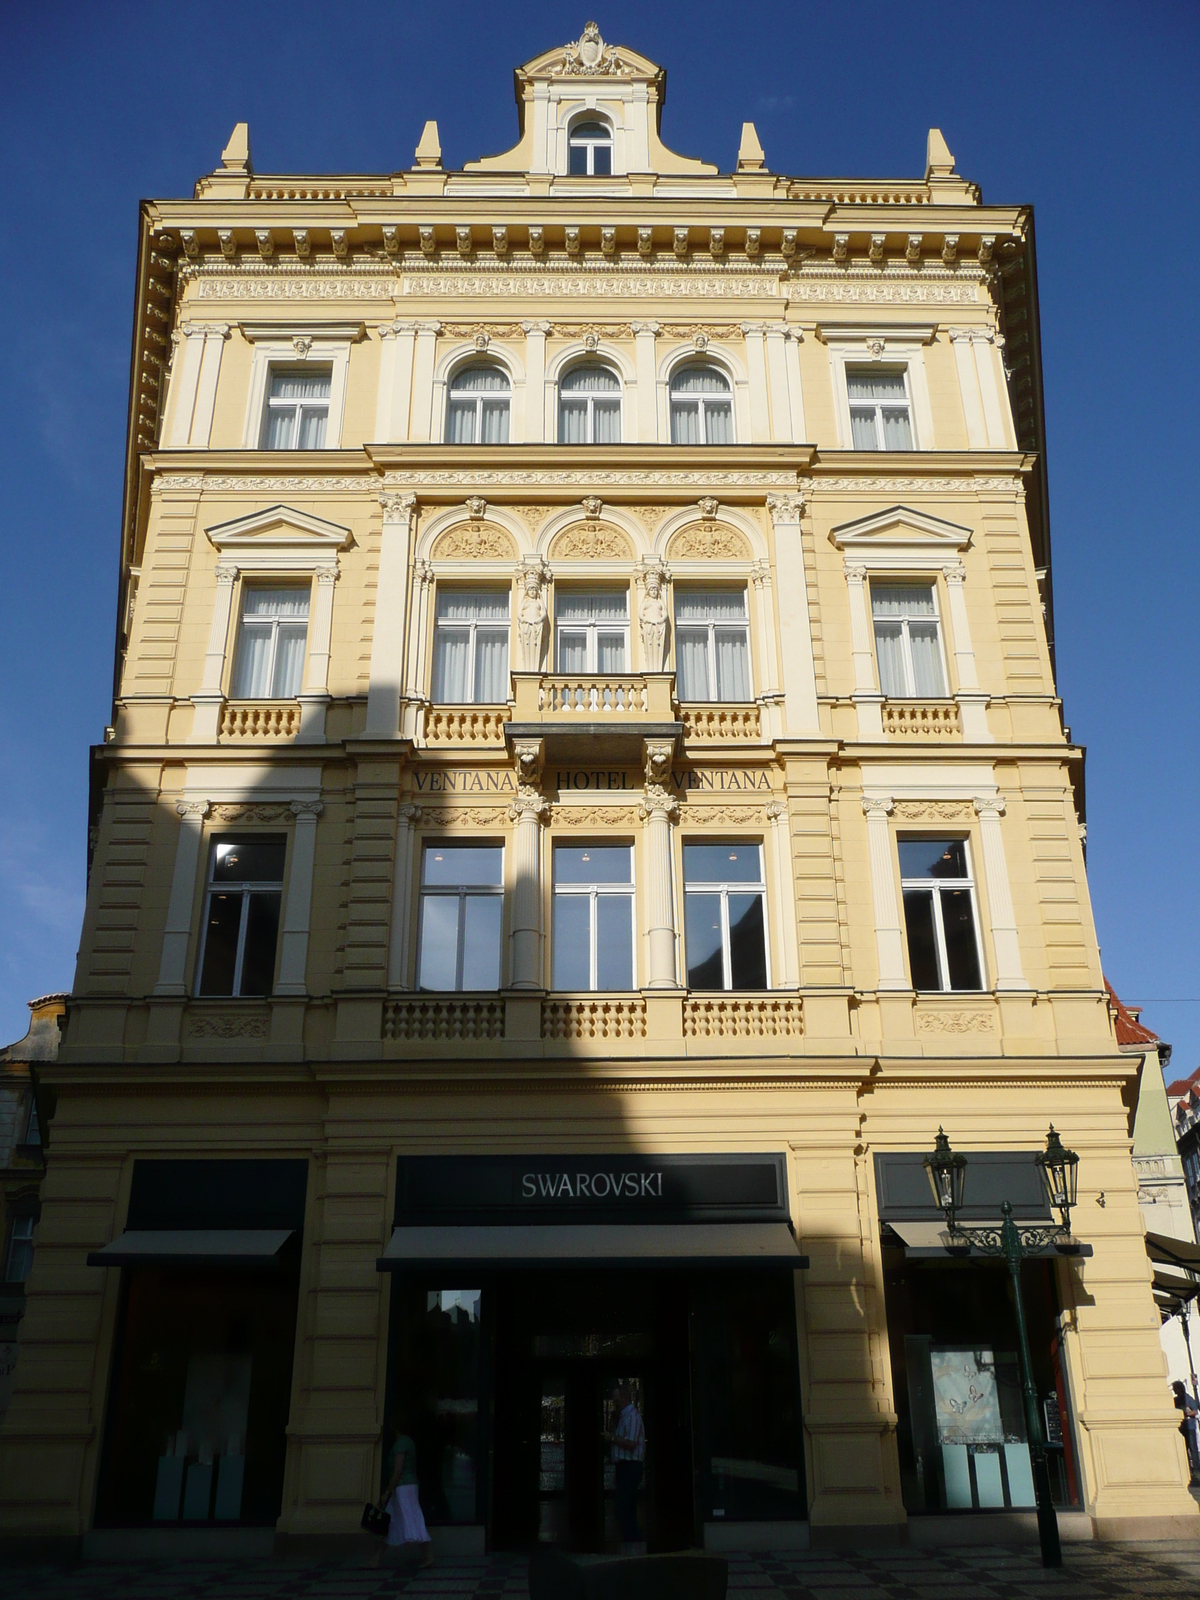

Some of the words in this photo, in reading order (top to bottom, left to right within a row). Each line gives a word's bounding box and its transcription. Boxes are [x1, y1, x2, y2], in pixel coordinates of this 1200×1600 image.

[413, 771, 515, 791] VENTANA
[556, 771, 634, 790] HOTEL
[671, 771, 771, 790] VENTANA
[522, 1173, 662, 1197] SWAROVSKI
